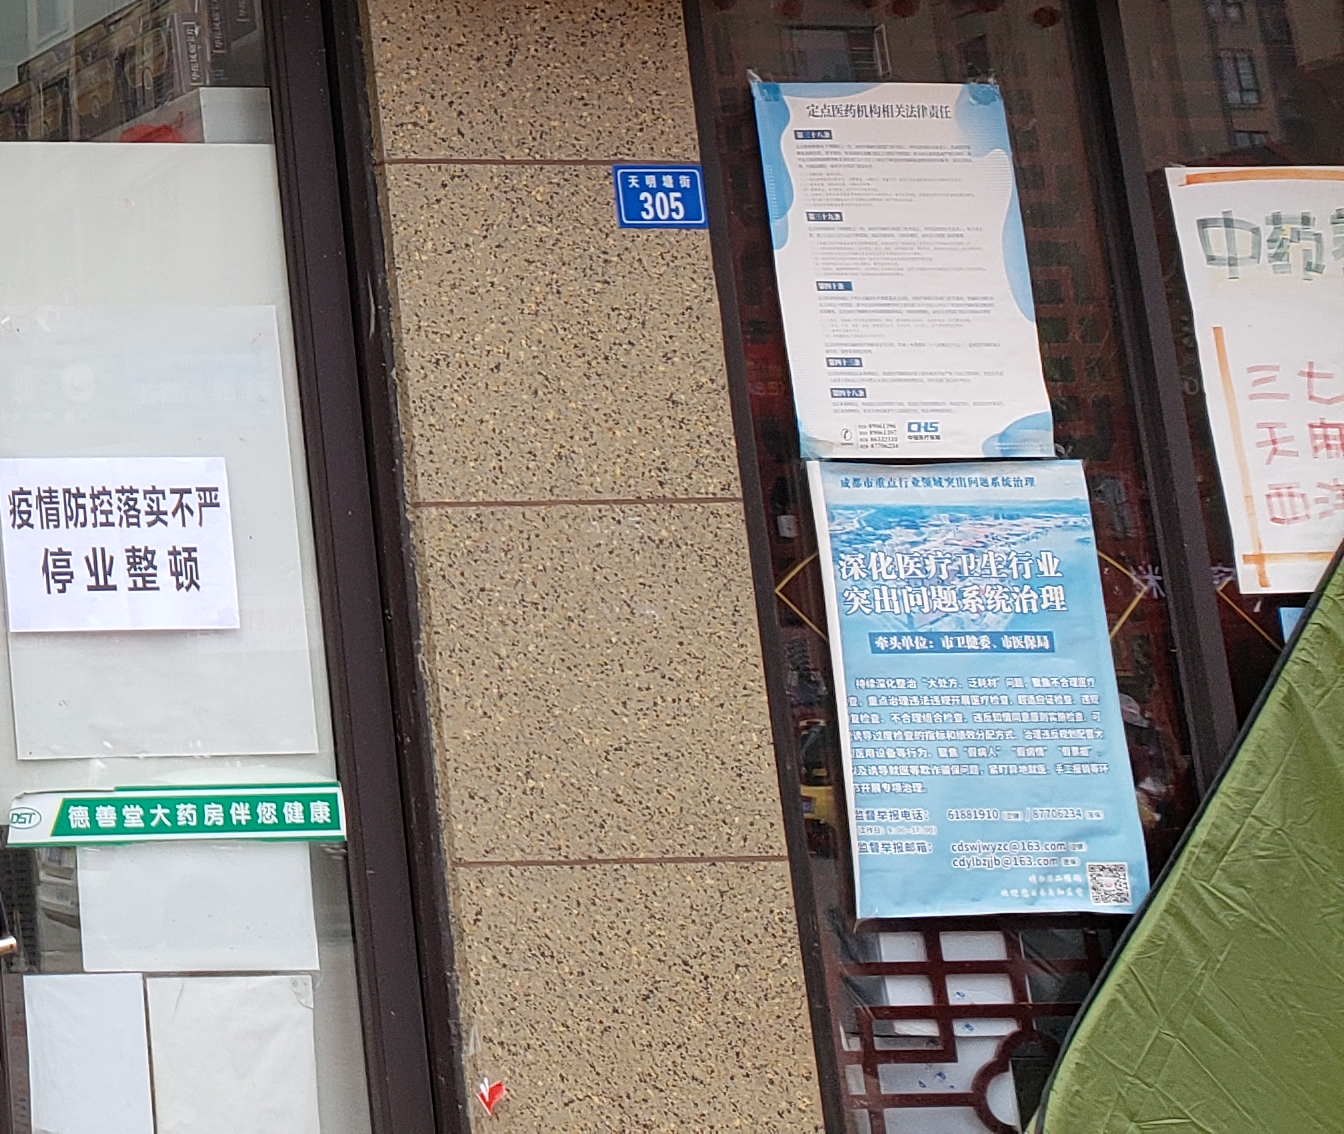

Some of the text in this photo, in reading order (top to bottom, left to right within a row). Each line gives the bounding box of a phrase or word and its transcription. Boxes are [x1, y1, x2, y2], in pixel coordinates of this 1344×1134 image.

[806, 103, 952, 119] 定点医药机构相关法律责任
[627, 174, 691, 190] 天明塘街
[638, 192, 686, 221] 305
[1247, 361, 1344, 405] 三七
[907, 421, 939, 432] CHS
[840, 476, 1036, 489] 成都市重点行业领域突出问题系统治理
[7, 484, 222, 531] 疫情防控落实不严
[40, 545, 202, 596] 停业整顿
[839, 550, 1063, 581] 深化医疗卫生行业
[843, 584, 1068, 615] 突出问题系统治理
[9, 812, 36, 825] DST
[68, 800, 332, 829] 德善堂大药房伴您健康
